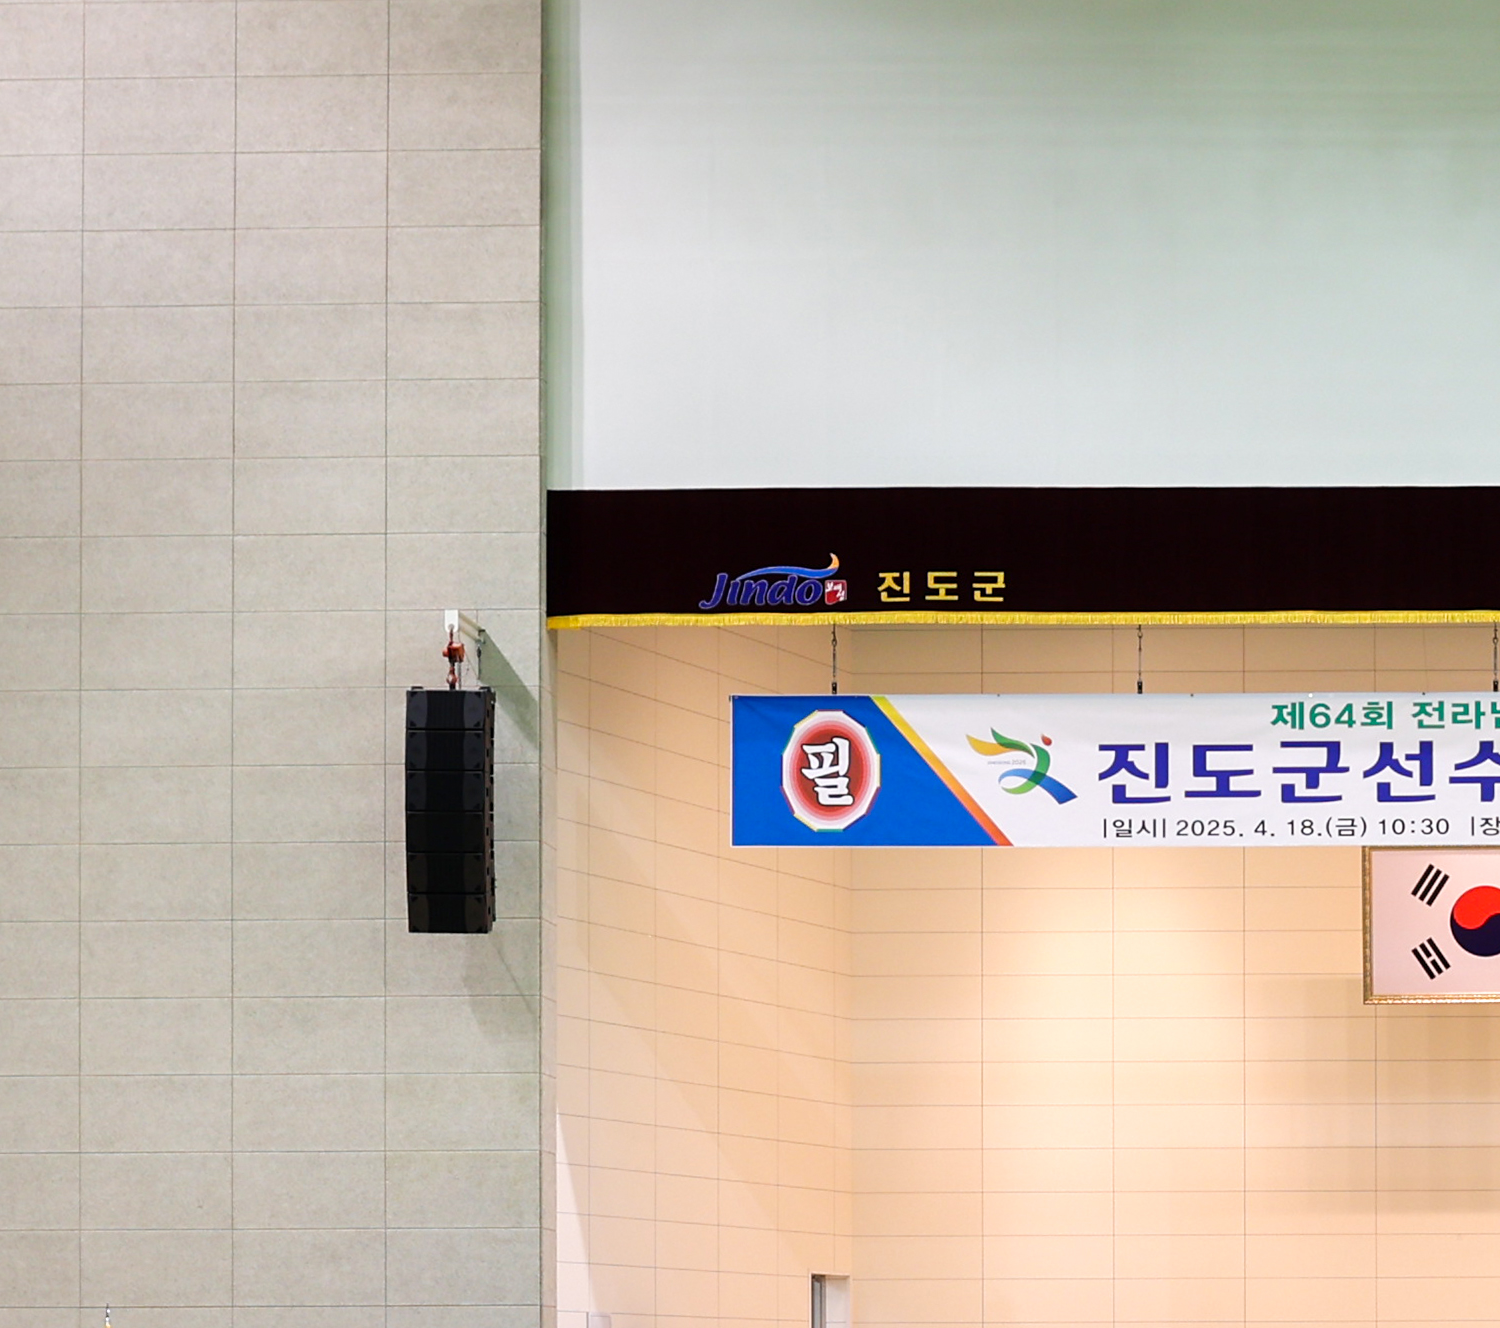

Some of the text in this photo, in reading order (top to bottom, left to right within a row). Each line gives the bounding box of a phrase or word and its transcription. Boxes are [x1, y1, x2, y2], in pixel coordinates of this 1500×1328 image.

[699, 573, 823, 609] Jindo
[877, 571, 1006, 602] 진도군
[1270, 700, 1395, 730] 제64회
[801, 736, 854, 806] 필
[1175, 819, 1244, 837] 2025.
[1253, 819, 1275, 837] 4.
[1379, 818, 1450, 836] 10:30
